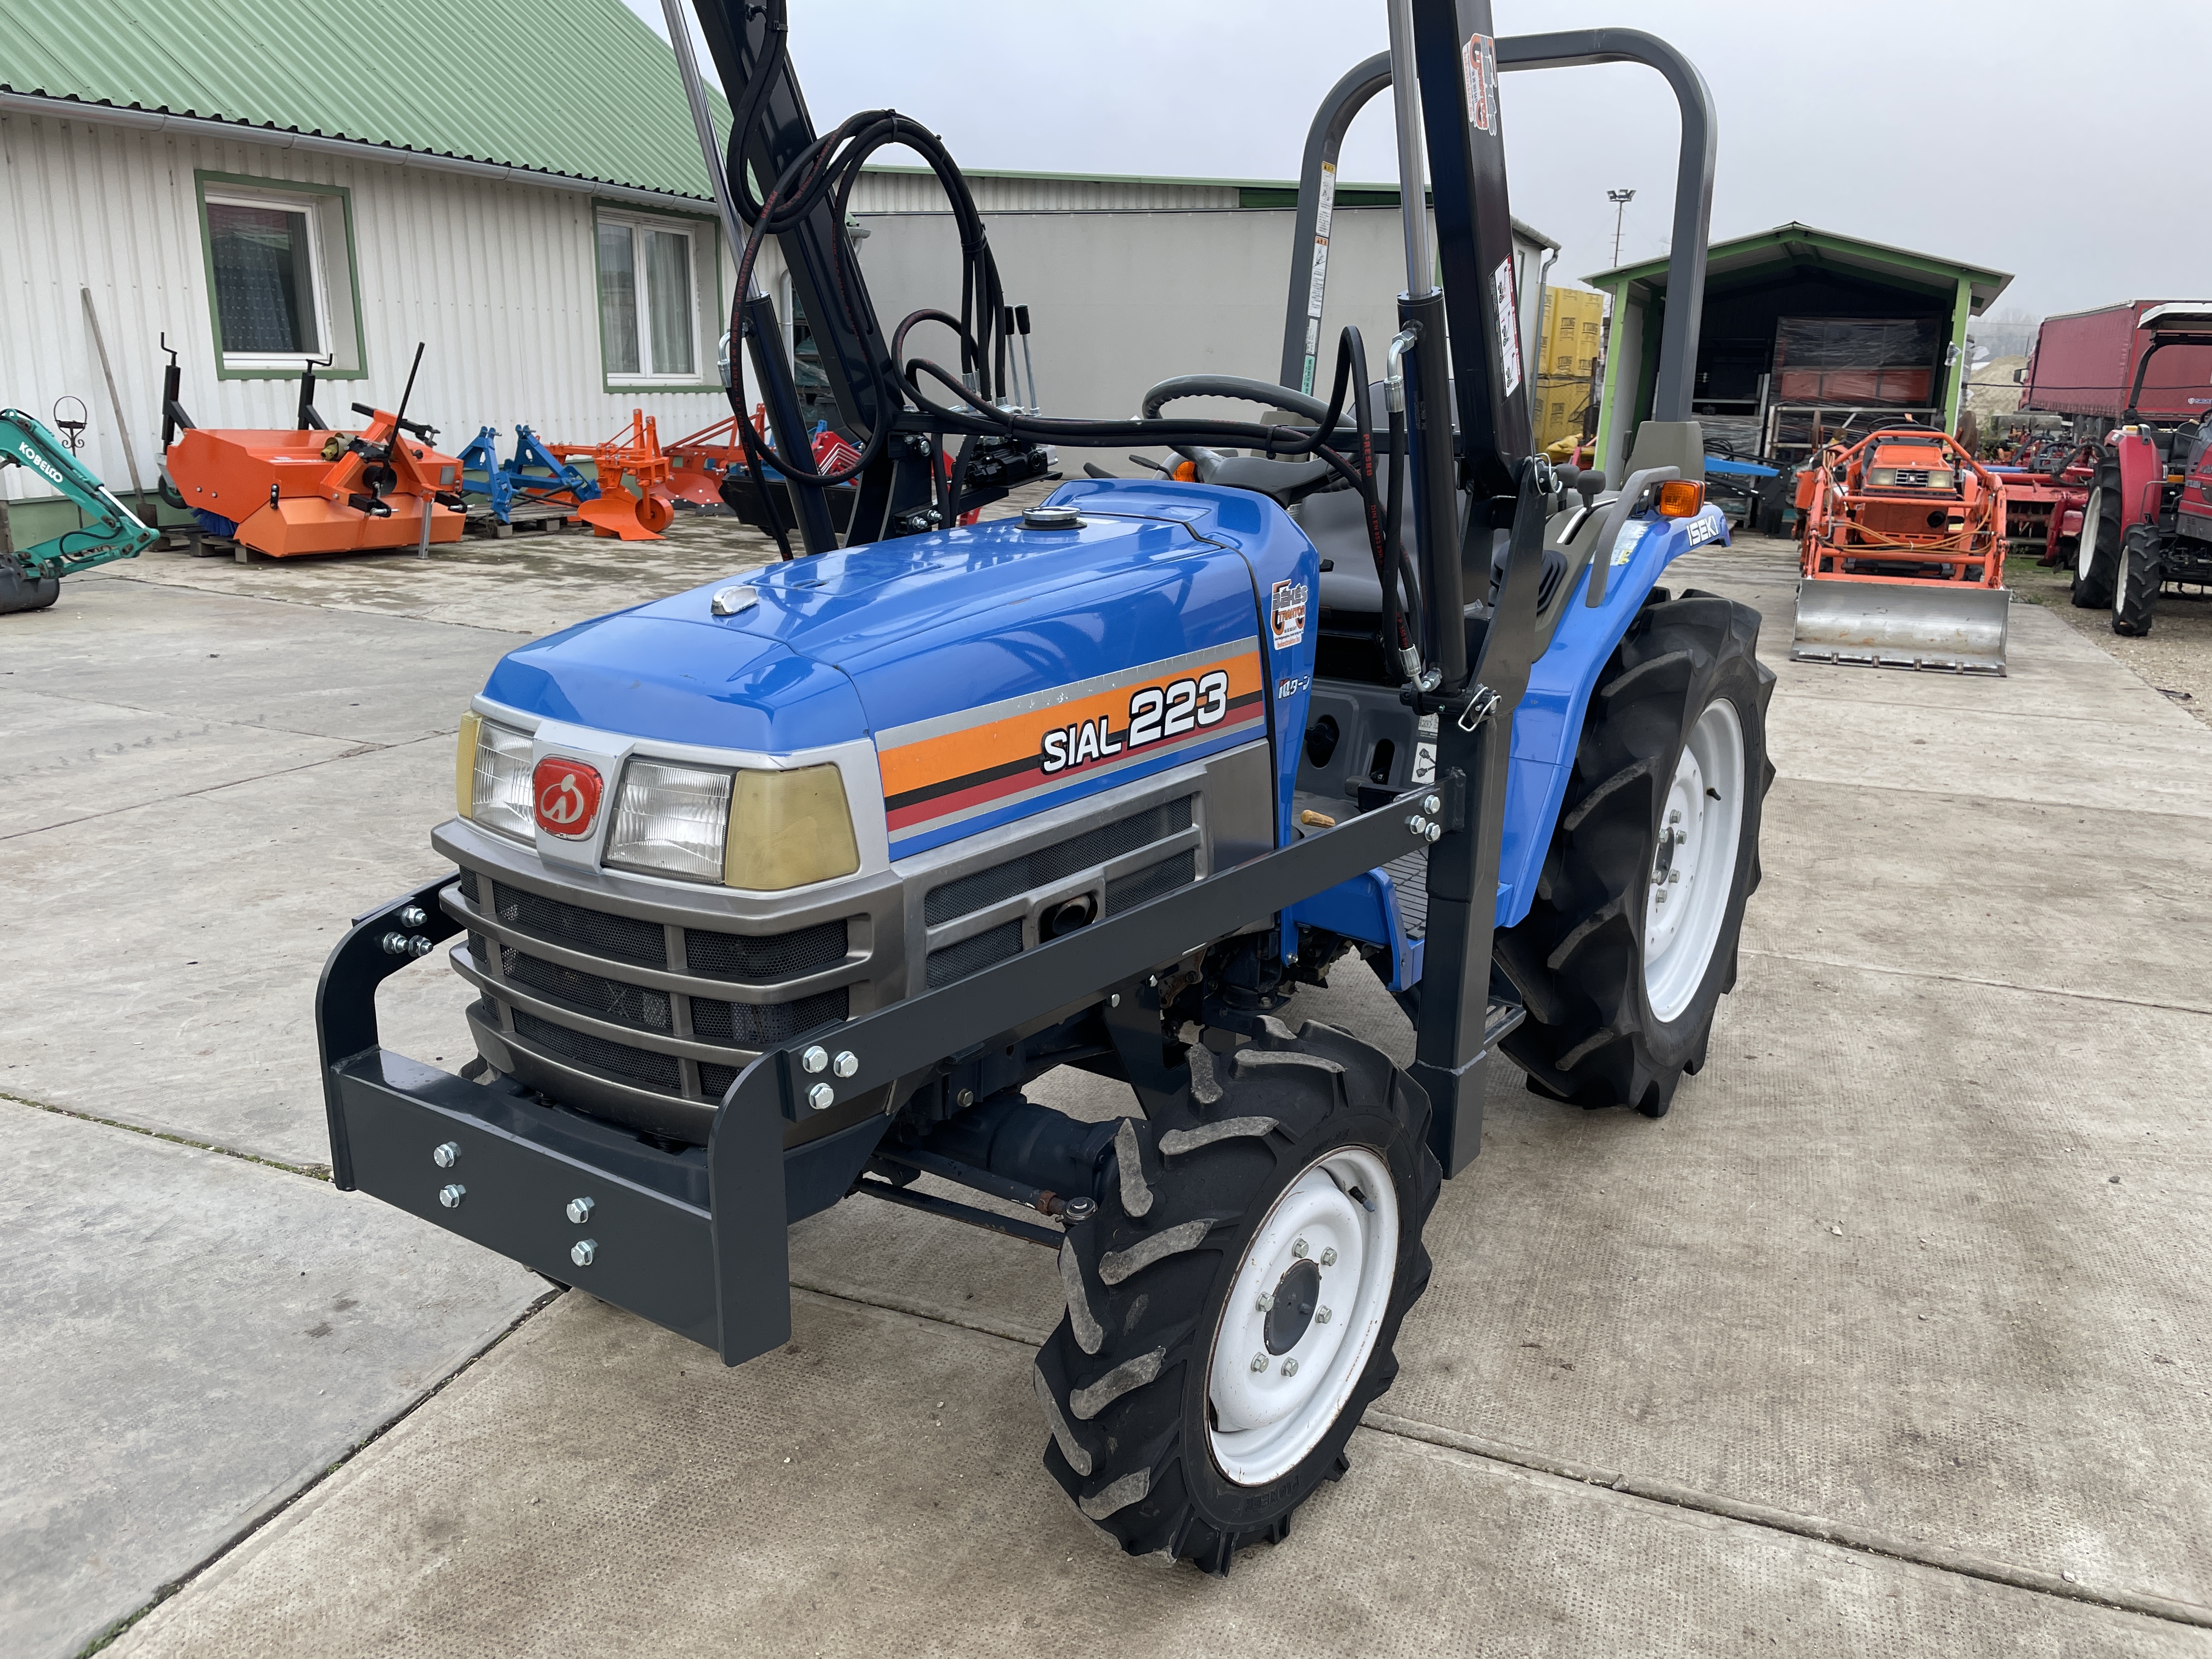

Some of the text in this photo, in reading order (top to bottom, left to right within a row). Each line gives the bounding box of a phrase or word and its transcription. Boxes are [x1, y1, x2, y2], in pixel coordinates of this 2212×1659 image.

[19, 442, 63, 482] KOBELCO
[1686, 515, 1719, 546] ISEKI
[1273, 584, 1307, 610] BÉKÉS
[1043, 671, 1228, 773] SIAL 223
